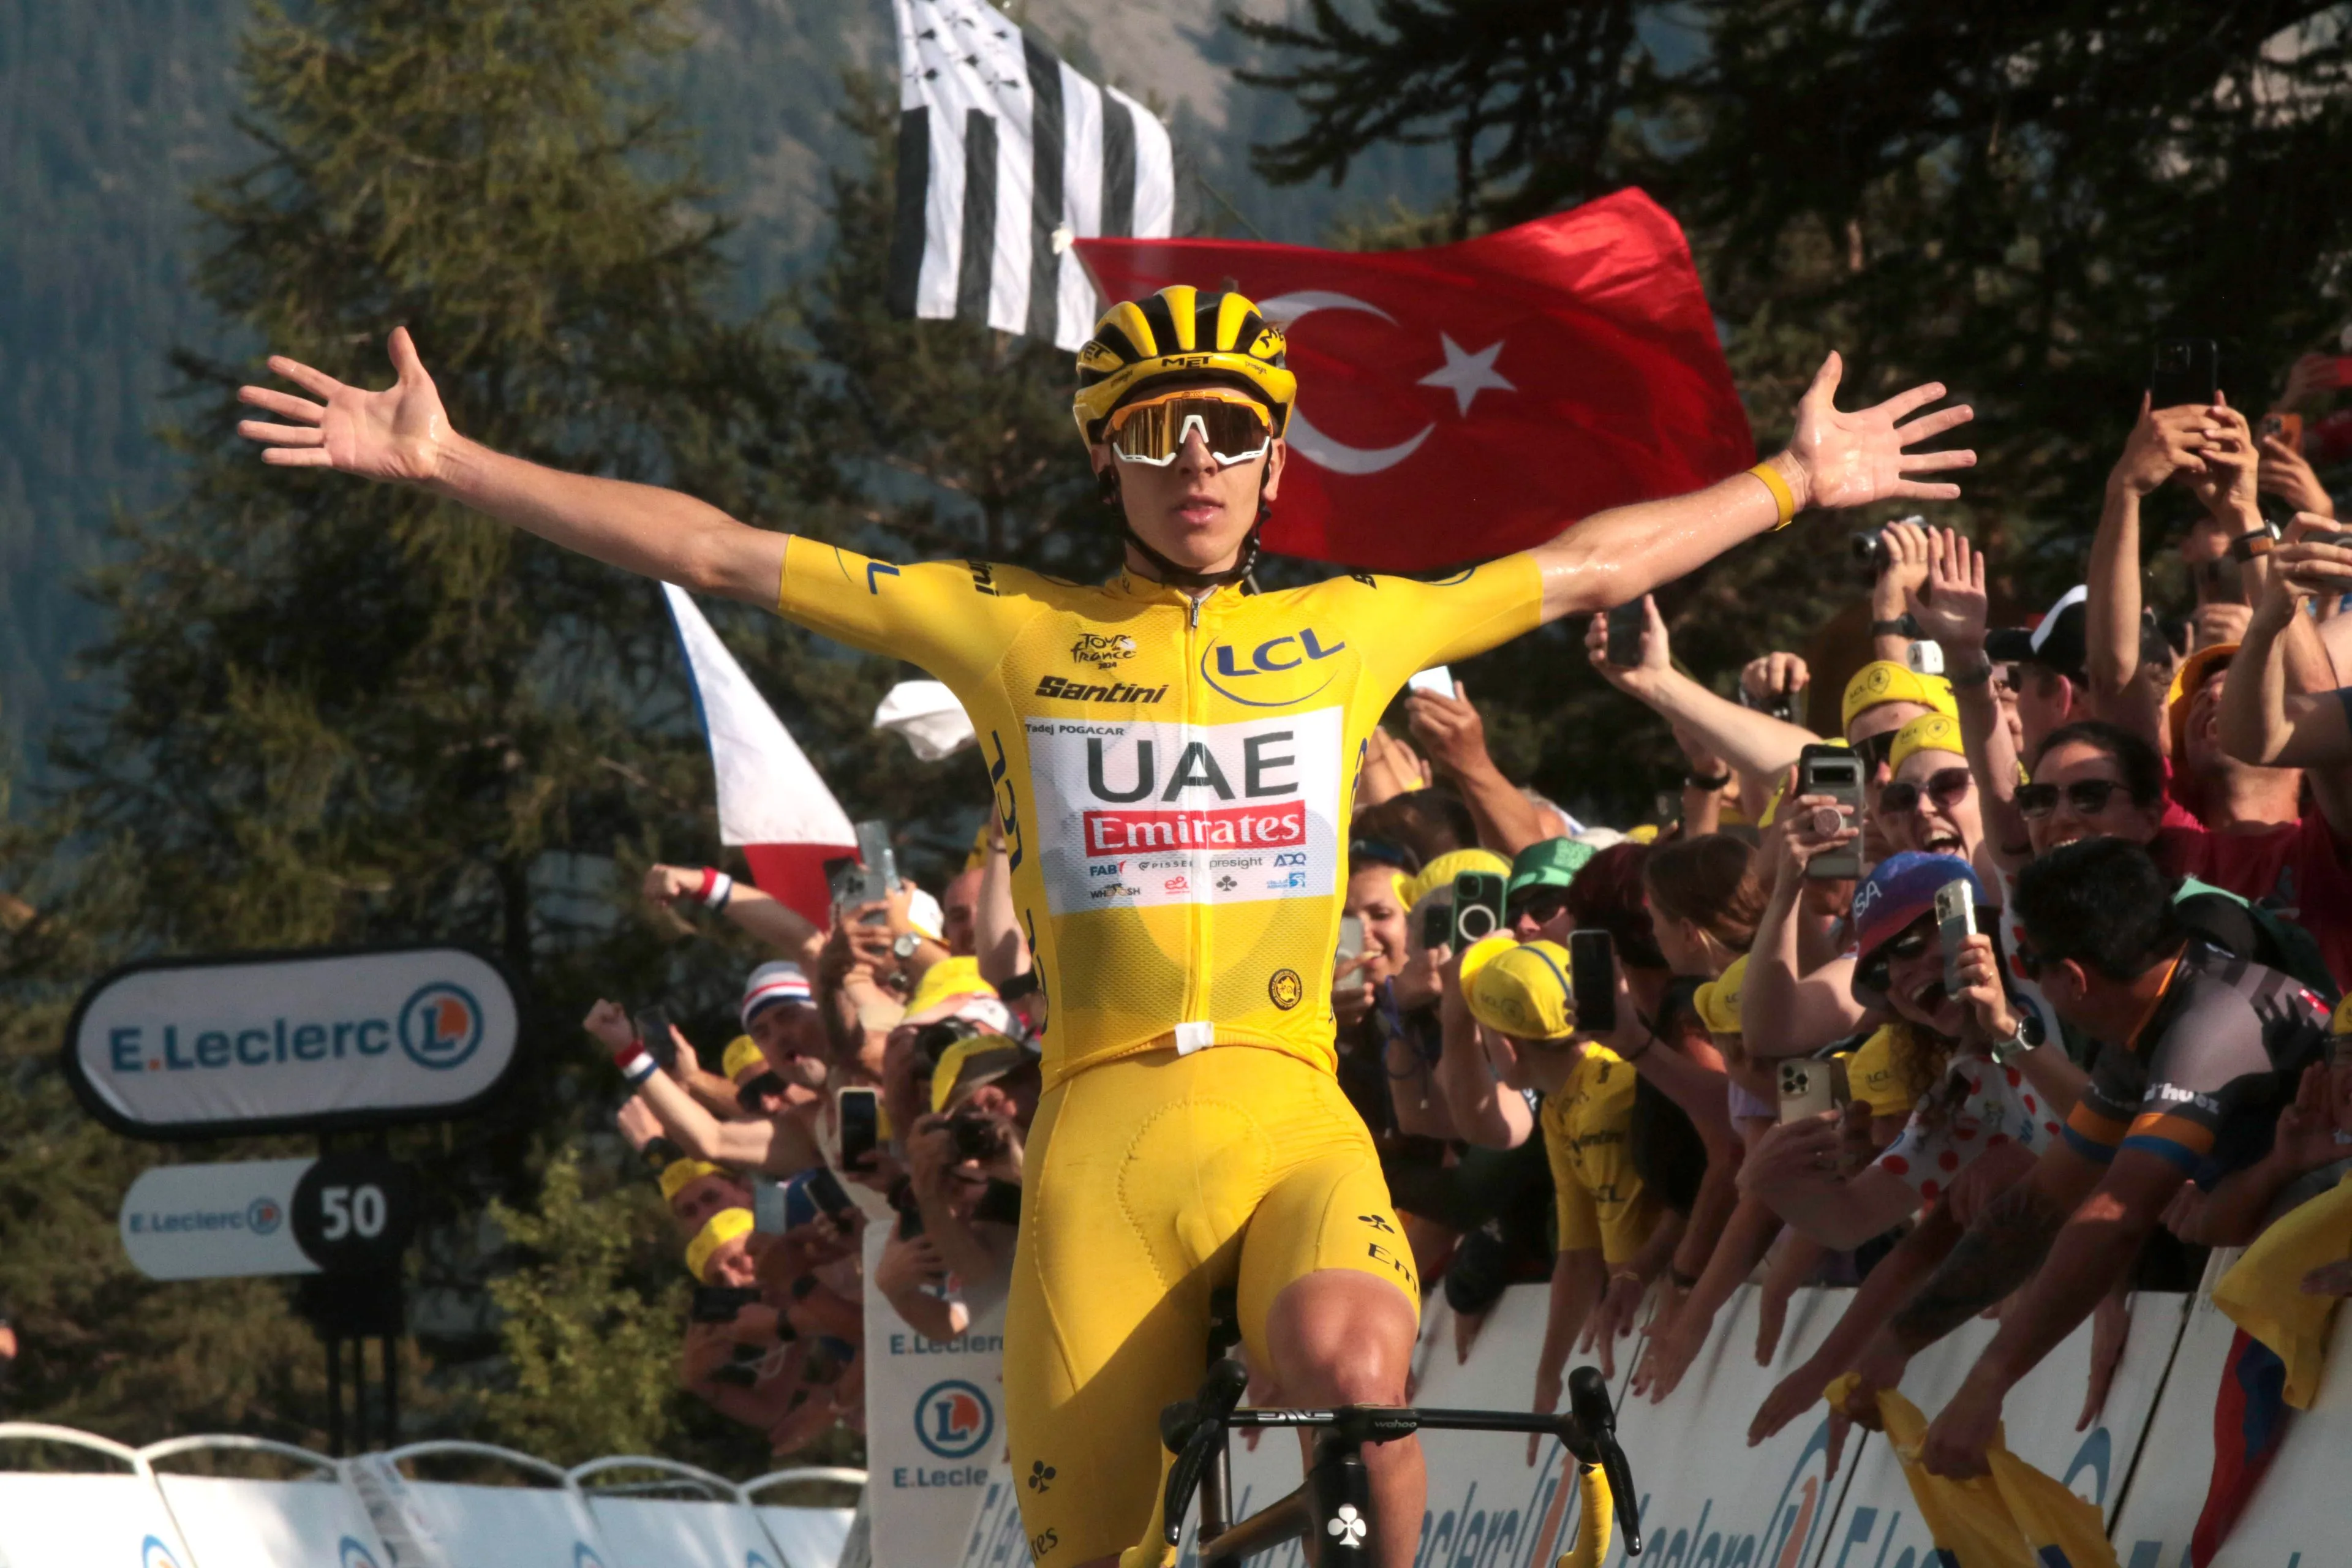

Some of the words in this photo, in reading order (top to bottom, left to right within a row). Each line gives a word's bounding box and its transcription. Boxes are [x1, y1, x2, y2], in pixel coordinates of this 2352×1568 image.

[1161, 355, 1213, 368] MET
[1216, 627, 1346, 675] LCL
[1035, 675, 1170, 704] Santini
[1025, 723, 1054, 736] Tadej
[1087, 731, 1299, 803] UAE
[1091, 813, 1301, 850] Emirates
[1090, 864, 1118, 876] FAB
[1209, 858, 1264, 870] presight
[108, 1017, 391, 1072] E.Leclerc
[320, 1184, 386, 1240] 50
[1374, 1419, 1417, 1428] wahoo
